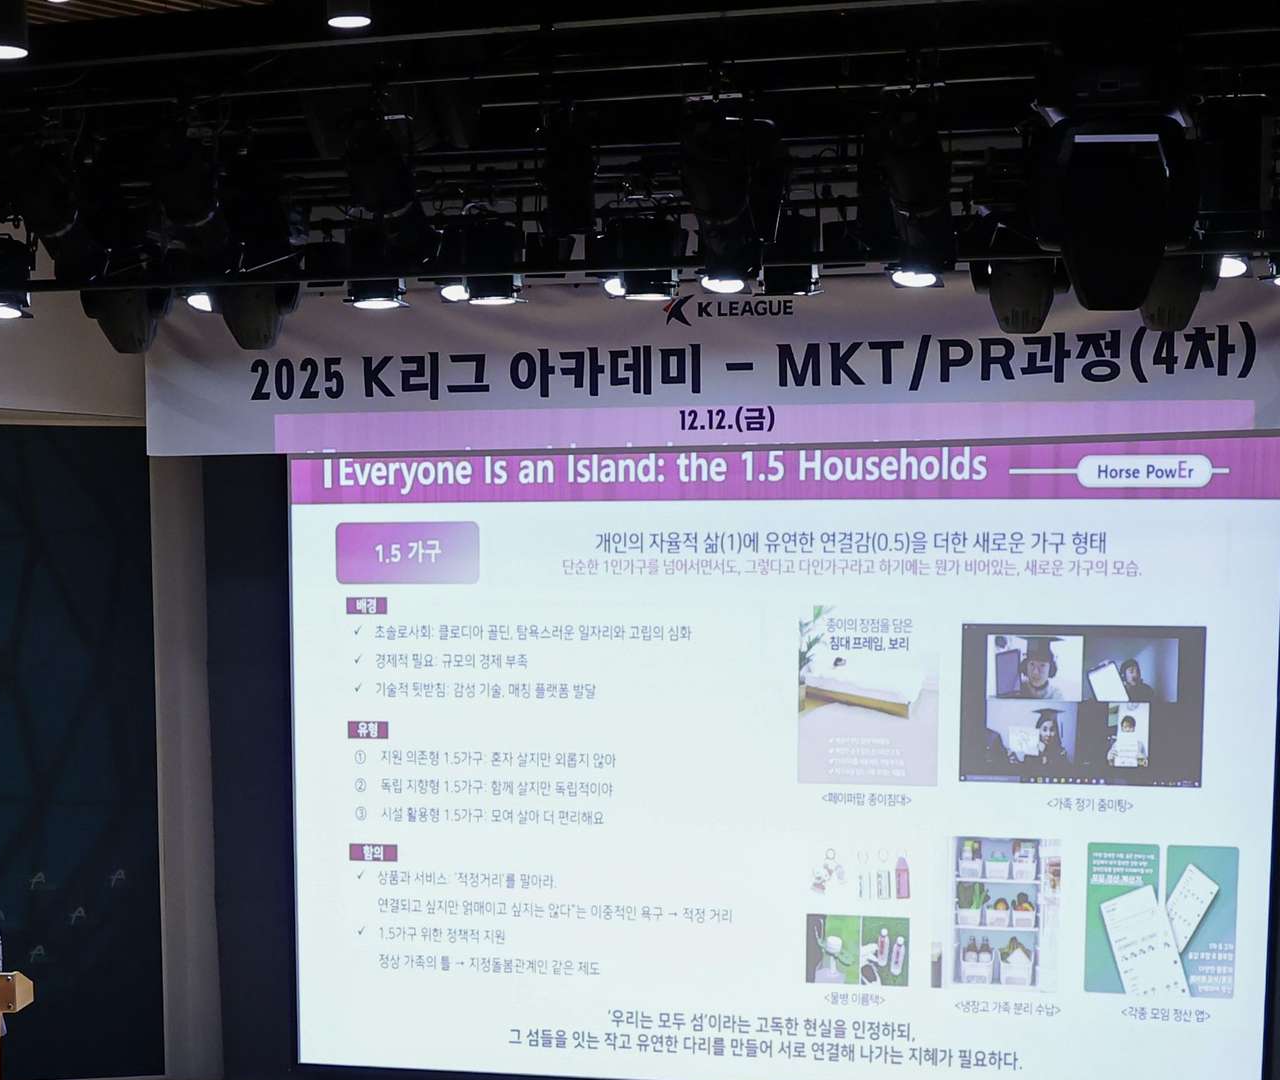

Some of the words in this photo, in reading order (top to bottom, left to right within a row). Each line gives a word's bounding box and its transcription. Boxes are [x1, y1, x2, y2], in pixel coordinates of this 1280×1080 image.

[697, 303, 713, 315] K
[718, 301, 792, 315] LEAGUE
[250, 357, 345, 400] 2025
[362, 352, 490, 400] K리그
[509, 344, 701, 398] 아카데미
[777, 321, 1257, 391] MKT/PR과정(4차)
[679, 406, 775, 431] 12.12.(금)
[338, 458, 473, 494] Everyone
[484, 456, 507, 484] Is
[518, 460, 554, 483] an
[567, 453, 665, 483] Island:
[676, 452, 727, 482] the
[741, 451, 784, 482] 1.5
[798, 446, 988, 482] Households
[1097, 463, 1140, 479] Horse
[1145, 461, 1193, 479] PowEr
[375, 542, 401, 563] 1.5
[408, 540, 441, 562] 가구
[596, 532, 643, 553] 개인의
[649, 532, 697, 553] 자율적
[704, 532, 759, 554] 삶(1)에
[765, 531, 815, 553] 유연한
[820, 531, 928, 554] 연결감(0.5)을
[934, 531, 968, 553] 더한
[973, 532, 1025, 554] 새로운
[1032, 531, 1065, 554] 가구
[1072, 531, 1106, 555] 형태
[1024, 560, 1064, 576] 새로운
[1069, 559, 1107, 576] 가구의
[658, 1013, 686, 1030] 모두
[756, 1017, 799, 1036] 고독한
[804, 1018, 847, 1038] 현실을
[852, 1021, 915, 1042] 인정하되,
[509, 1029, 522, 1044] 그
[527, 1029, 567, 1048] 섬들을
[573, 1031, 600, 1049] 잇는
[605, 1032, 632, 1051] 작고
[636, 1034, 678, 1053] 유연한
[684, 1036, 725, 1056] 다리를
[731, 1038, 772, 1058] 만들어
[778, 1041, 806, 1059] 서로
[812, 1043, 854, 1062] 연결해
[860, 1045, 903, 1064] 나가는
[909, 1047, 953, 1067] 지혜가
[959, 1050, 1022, 1070] 필요하다.
